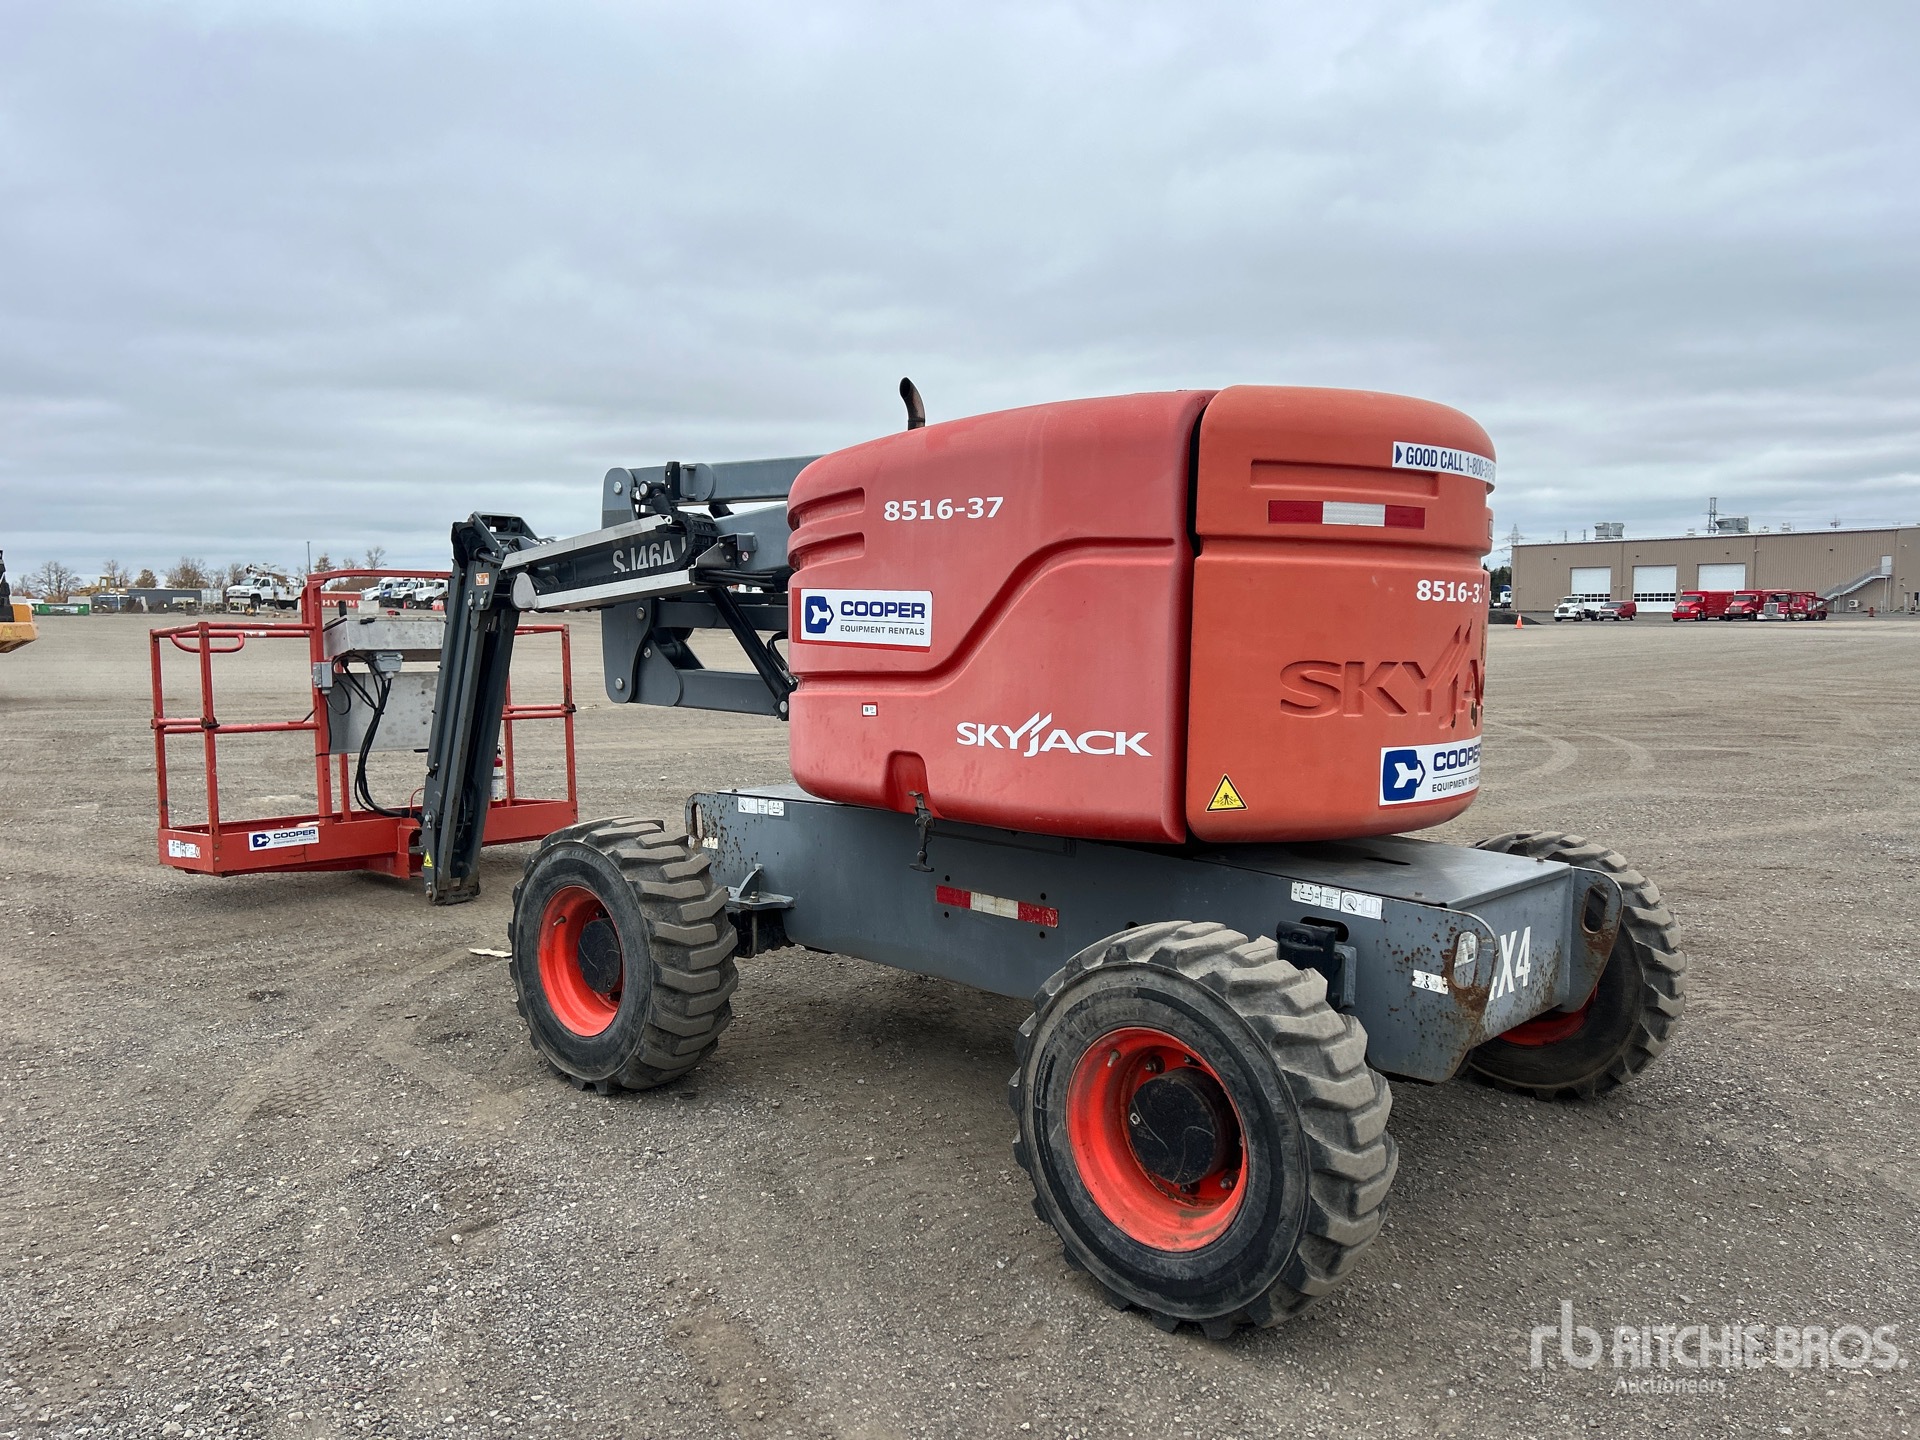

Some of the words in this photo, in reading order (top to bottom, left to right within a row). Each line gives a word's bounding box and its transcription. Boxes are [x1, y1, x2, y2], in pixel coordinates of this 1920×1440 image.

[1406, 447, 1438, 468] GOOD
[1440, 450, 1464, 472] CALL
[883, 496, 1004, 521] 8516-37
[840, 600, 926, 619] COOPER
[840, 624, 886, 634] EQUIPMENT
[888, 626, 925, 636] RENTALS
[956, 711, 1153, 758] SKYJACK
[1432, 777, 1468, 793] EQUIPMENT
[273, 829, 316, 839] COOPER
